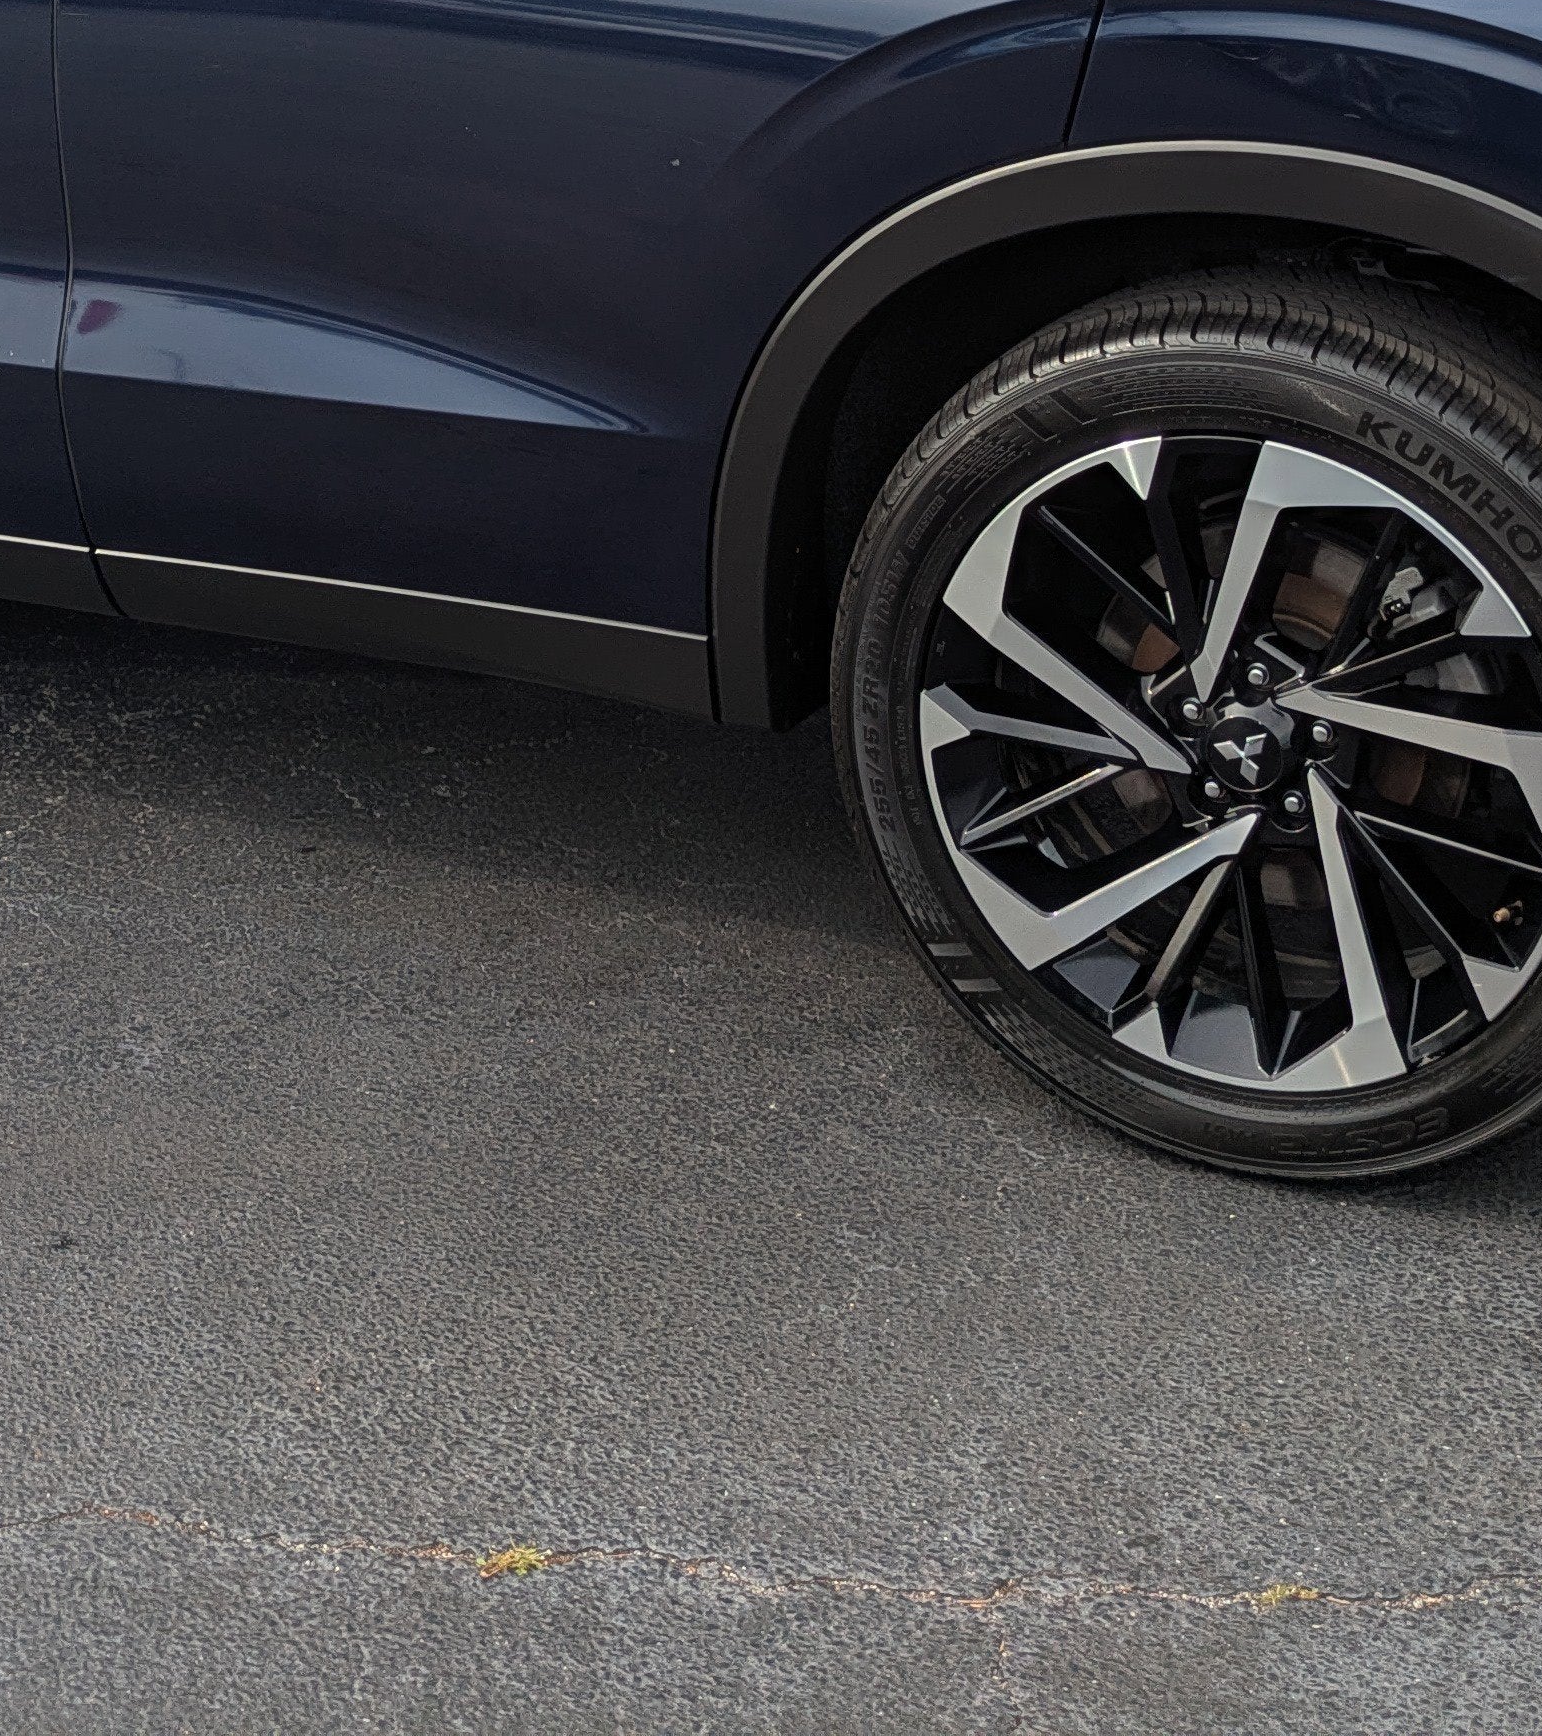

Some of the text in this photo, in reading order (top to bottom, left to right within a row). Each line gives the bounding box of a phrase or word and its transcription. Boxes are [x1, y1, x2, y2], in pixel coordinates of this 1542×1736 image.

[1355, 410, 1542, 562] KUMHO
[860, 639, 884, 721] ZR20
[860, 724, 895, 832] 255/45
